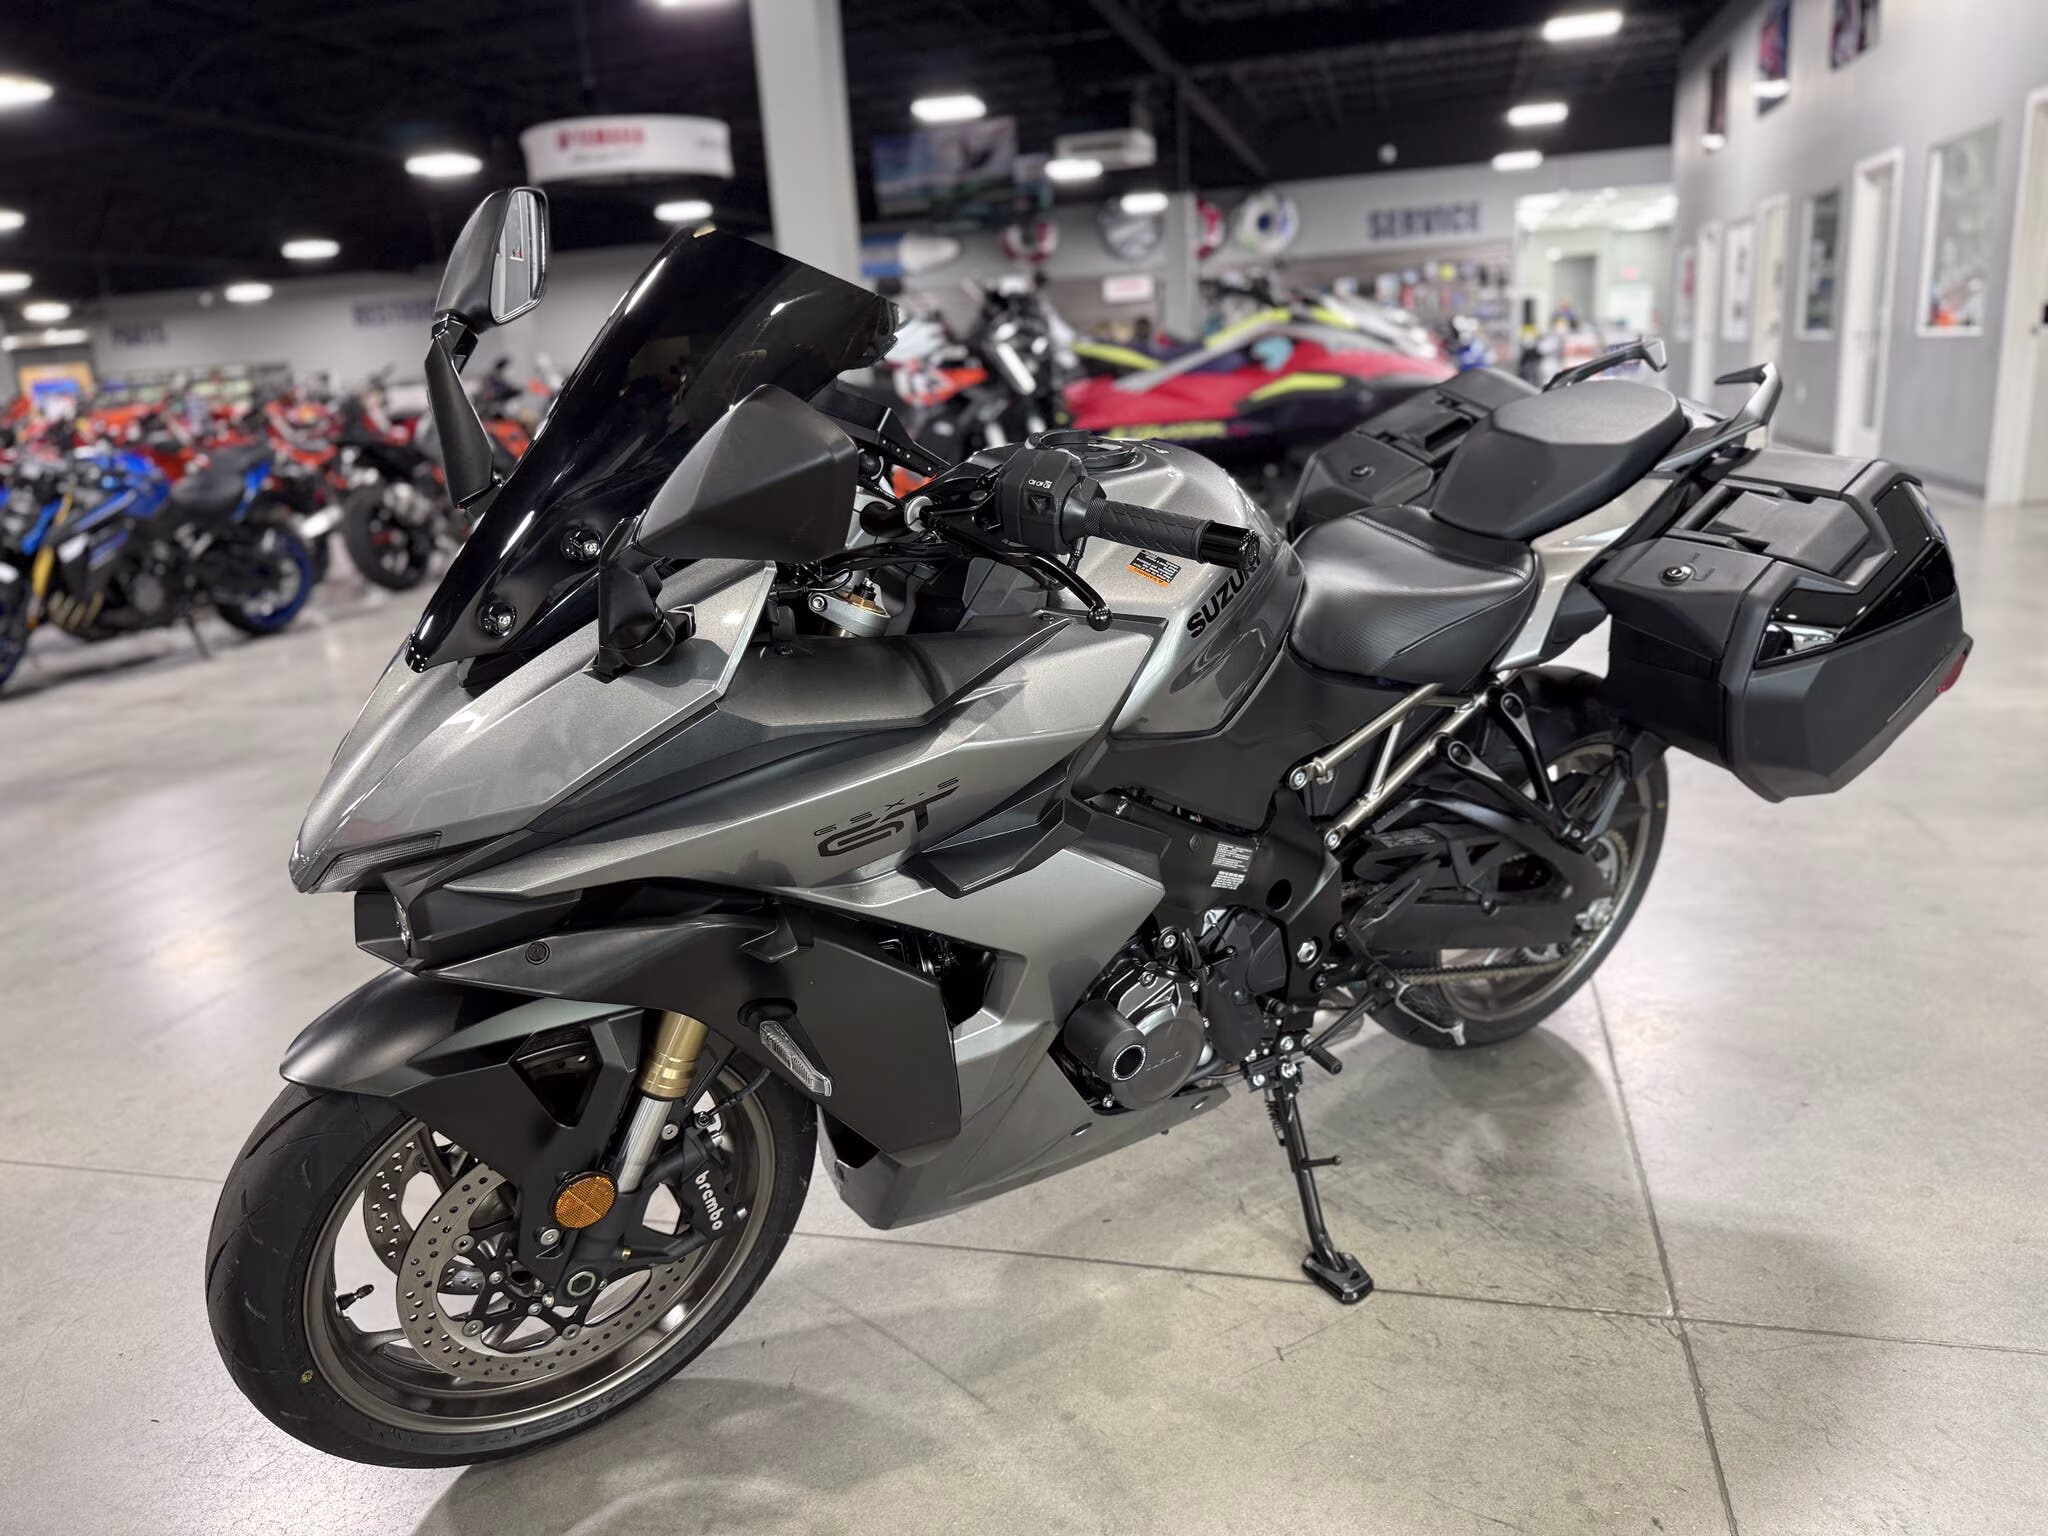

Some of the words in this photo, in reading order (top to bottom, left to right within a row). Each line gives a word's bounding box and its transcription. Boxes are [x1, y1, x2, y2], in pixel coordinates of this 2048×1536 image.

[1367, 201, 1482, 241] SERVICE
[1186, 555, 1261, 639] SUZU
[817, 785, 960, 858] GT
[694, 1169, 725, 1231] brembo
